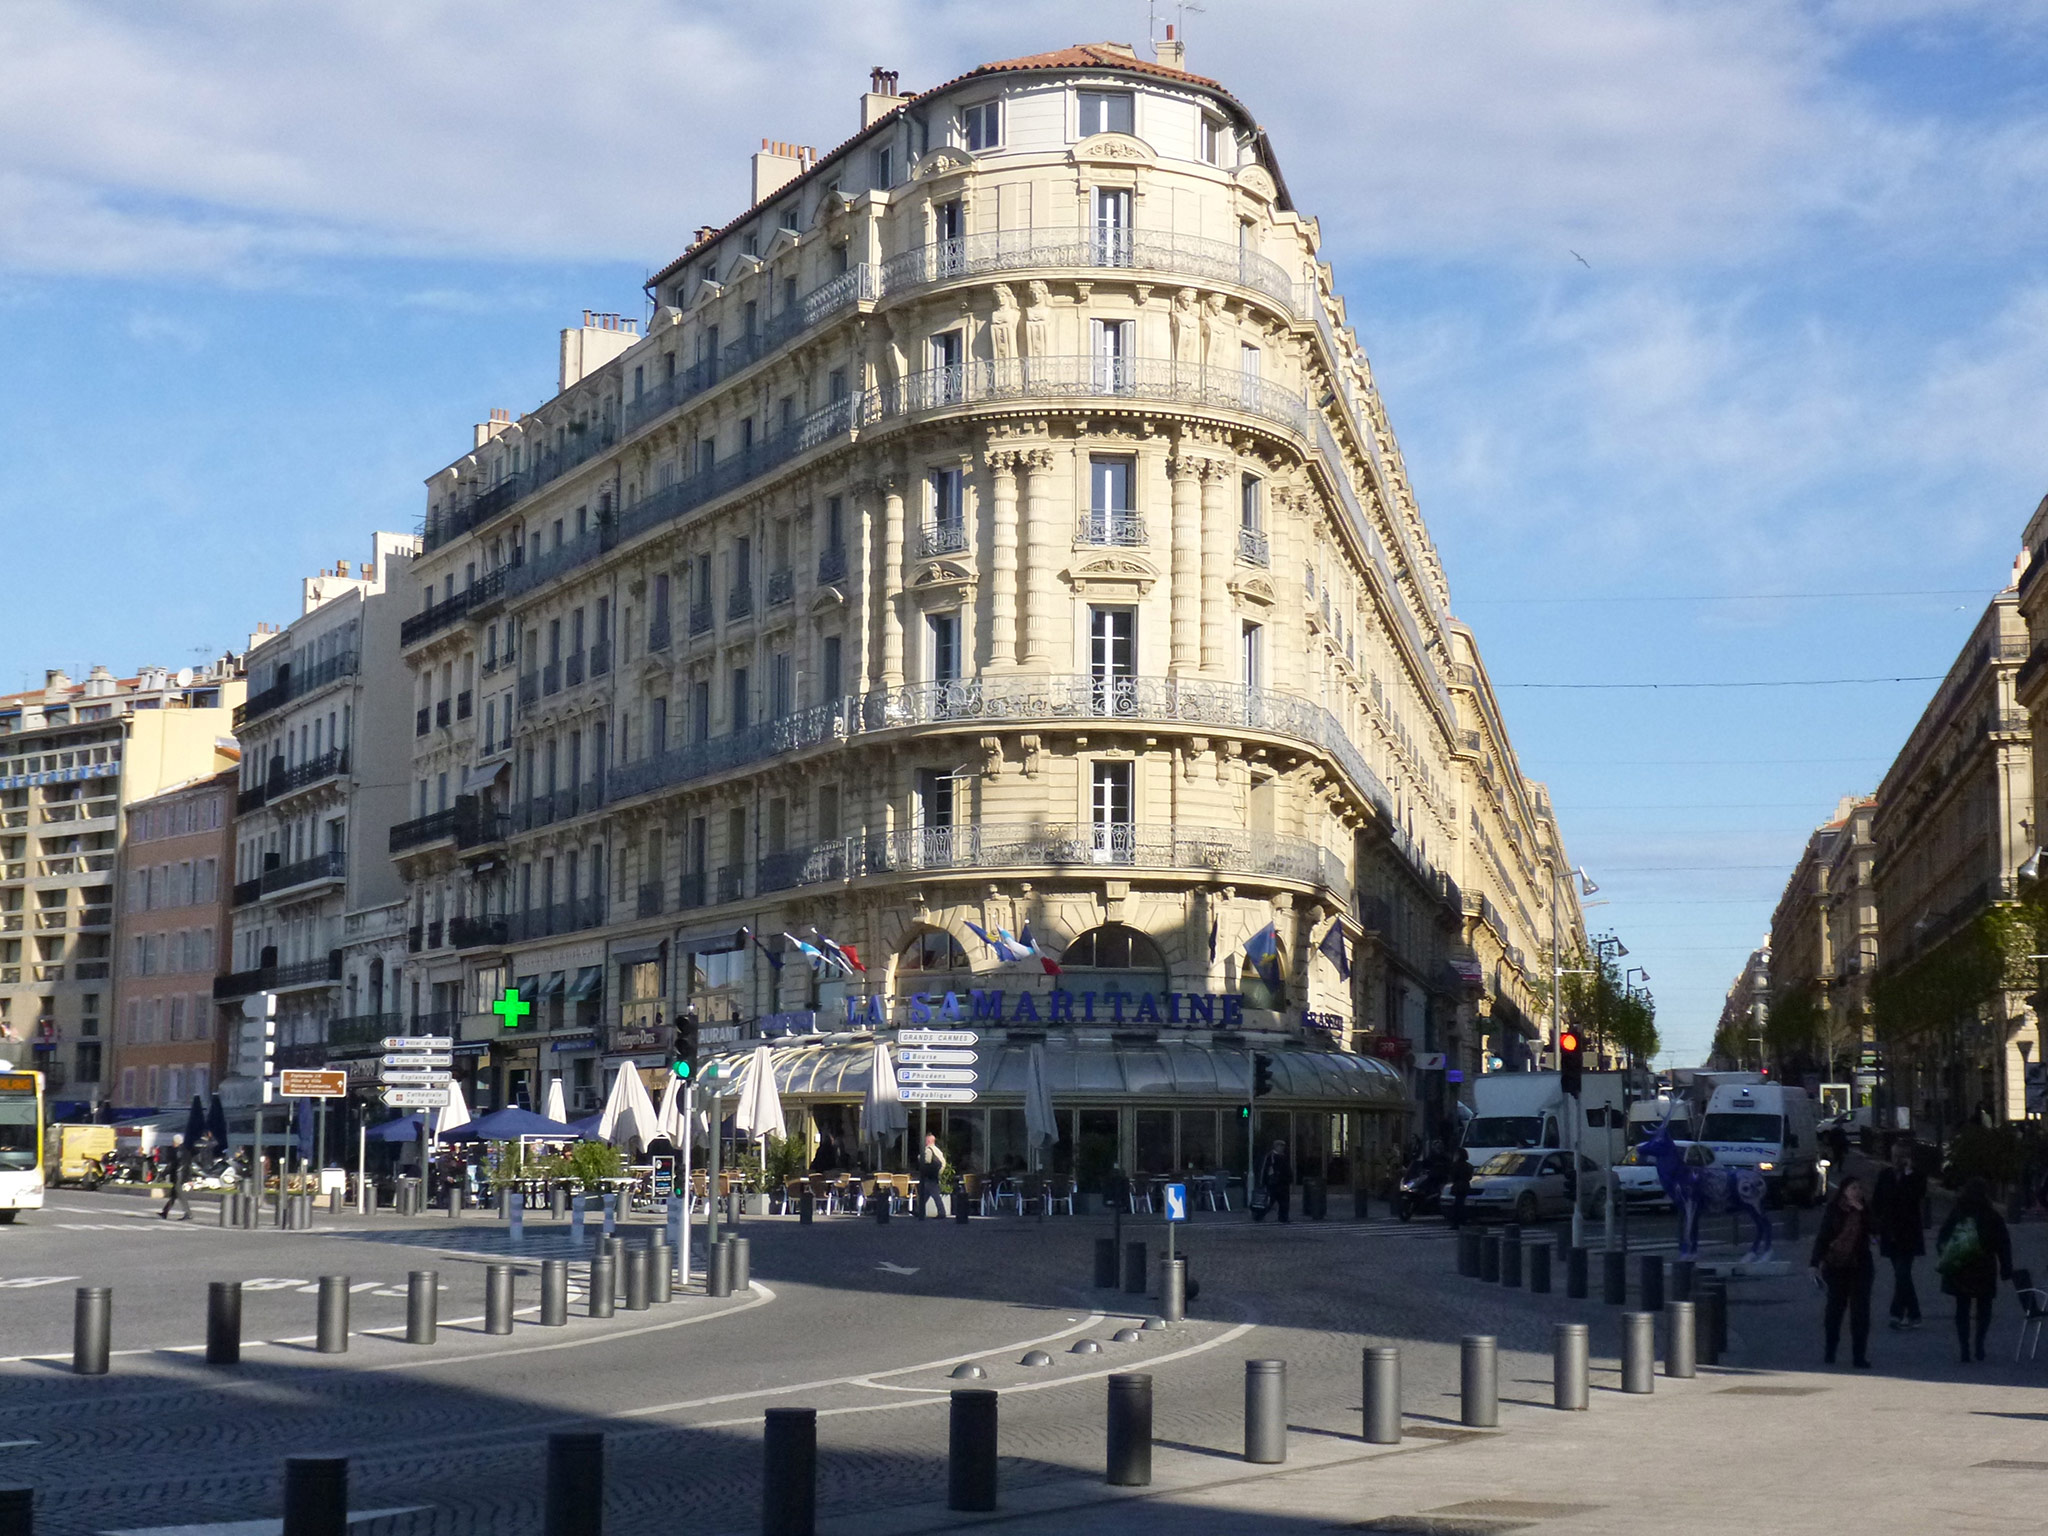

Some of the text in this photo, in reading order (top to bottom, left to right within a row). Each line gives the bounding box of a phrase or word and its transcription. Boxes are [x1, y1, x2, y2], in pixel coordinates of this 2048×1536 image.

[846, 994, 884, 1025] LA
[911, 989, 1243, 1025] SAMARITAINE
[937, 1034, 968, 1042] CARMES
